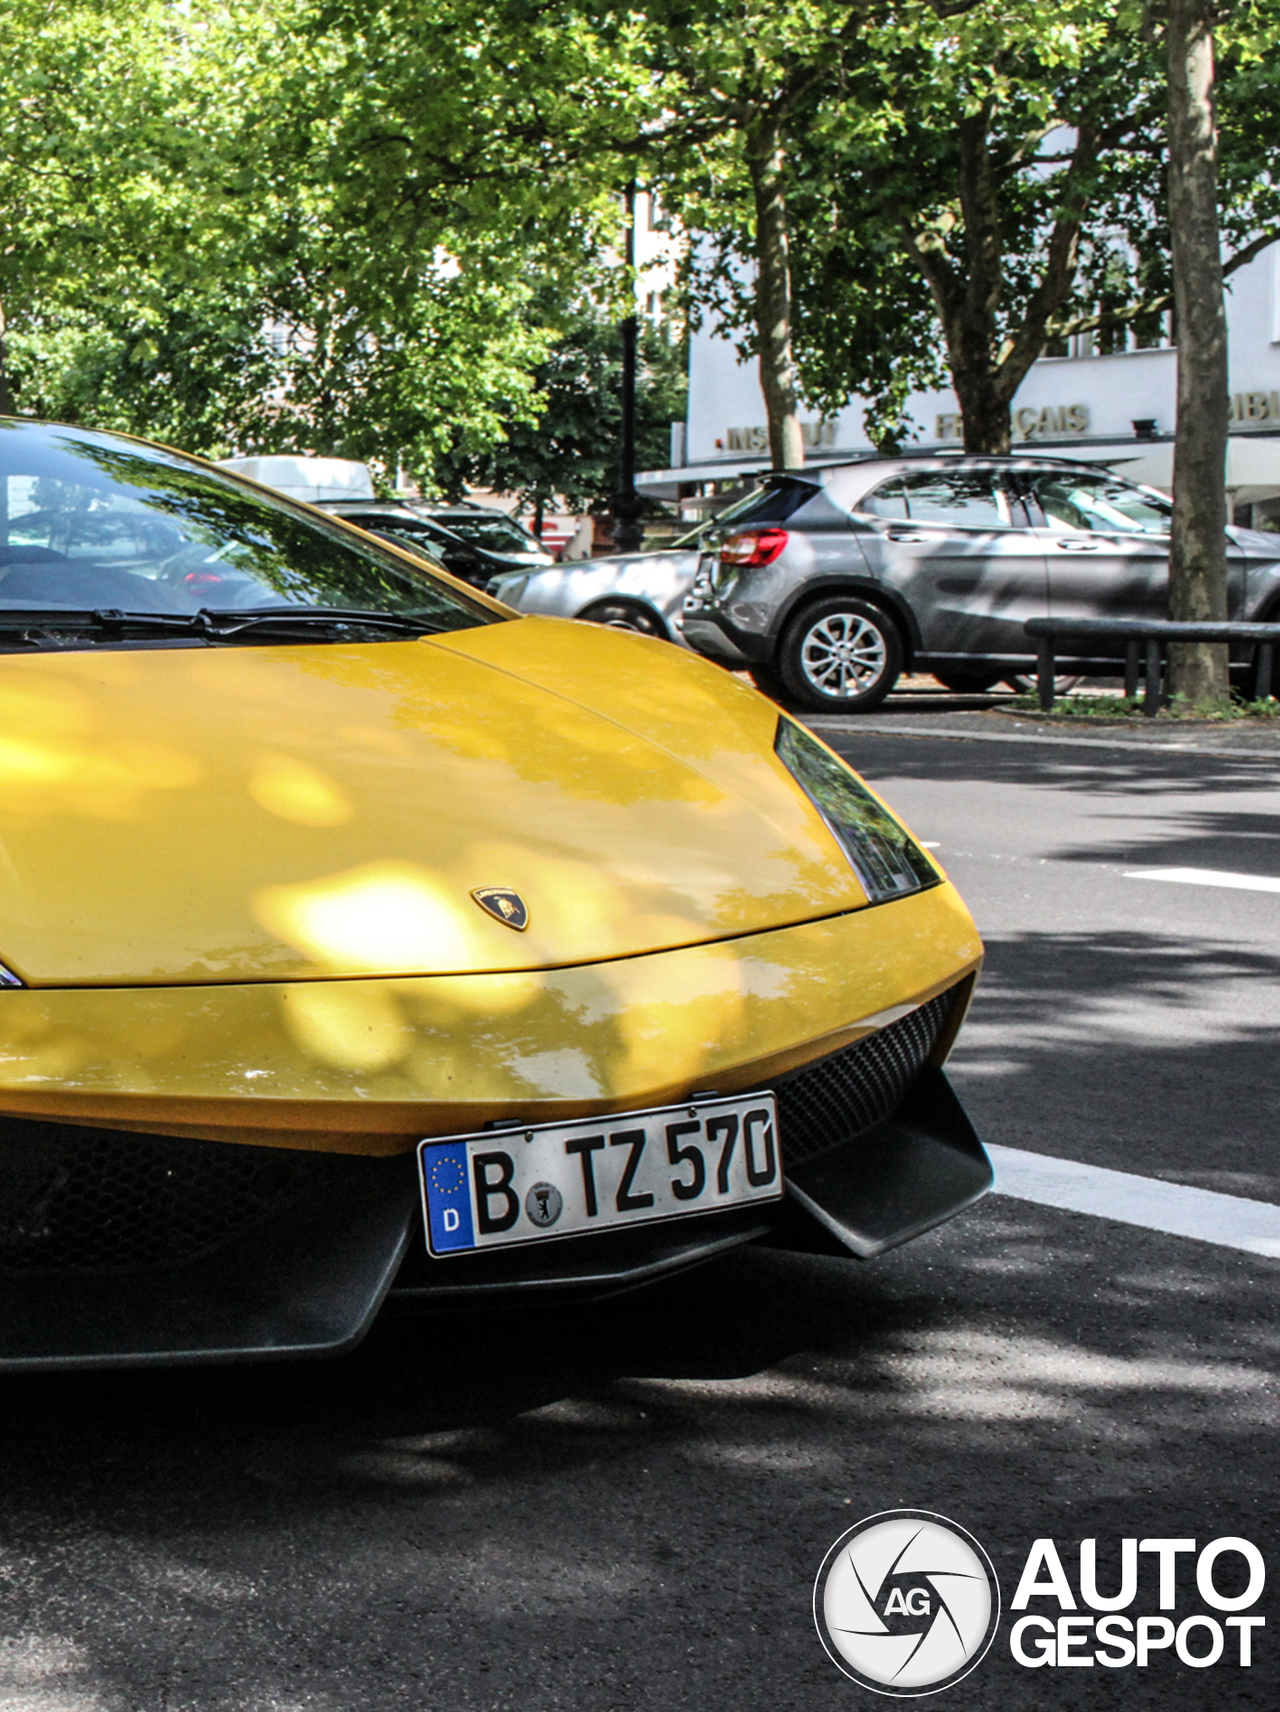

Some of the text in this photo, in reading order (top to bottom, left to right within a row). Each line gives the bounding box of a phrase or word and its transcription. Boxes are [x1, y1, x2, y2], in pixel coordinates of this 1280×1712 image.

[727, 404, 1090, 450] INSUT FRÇAIS
[473, 1108, 777, 1235] B TZ 570
[443, 1208, 460, 1232] D
